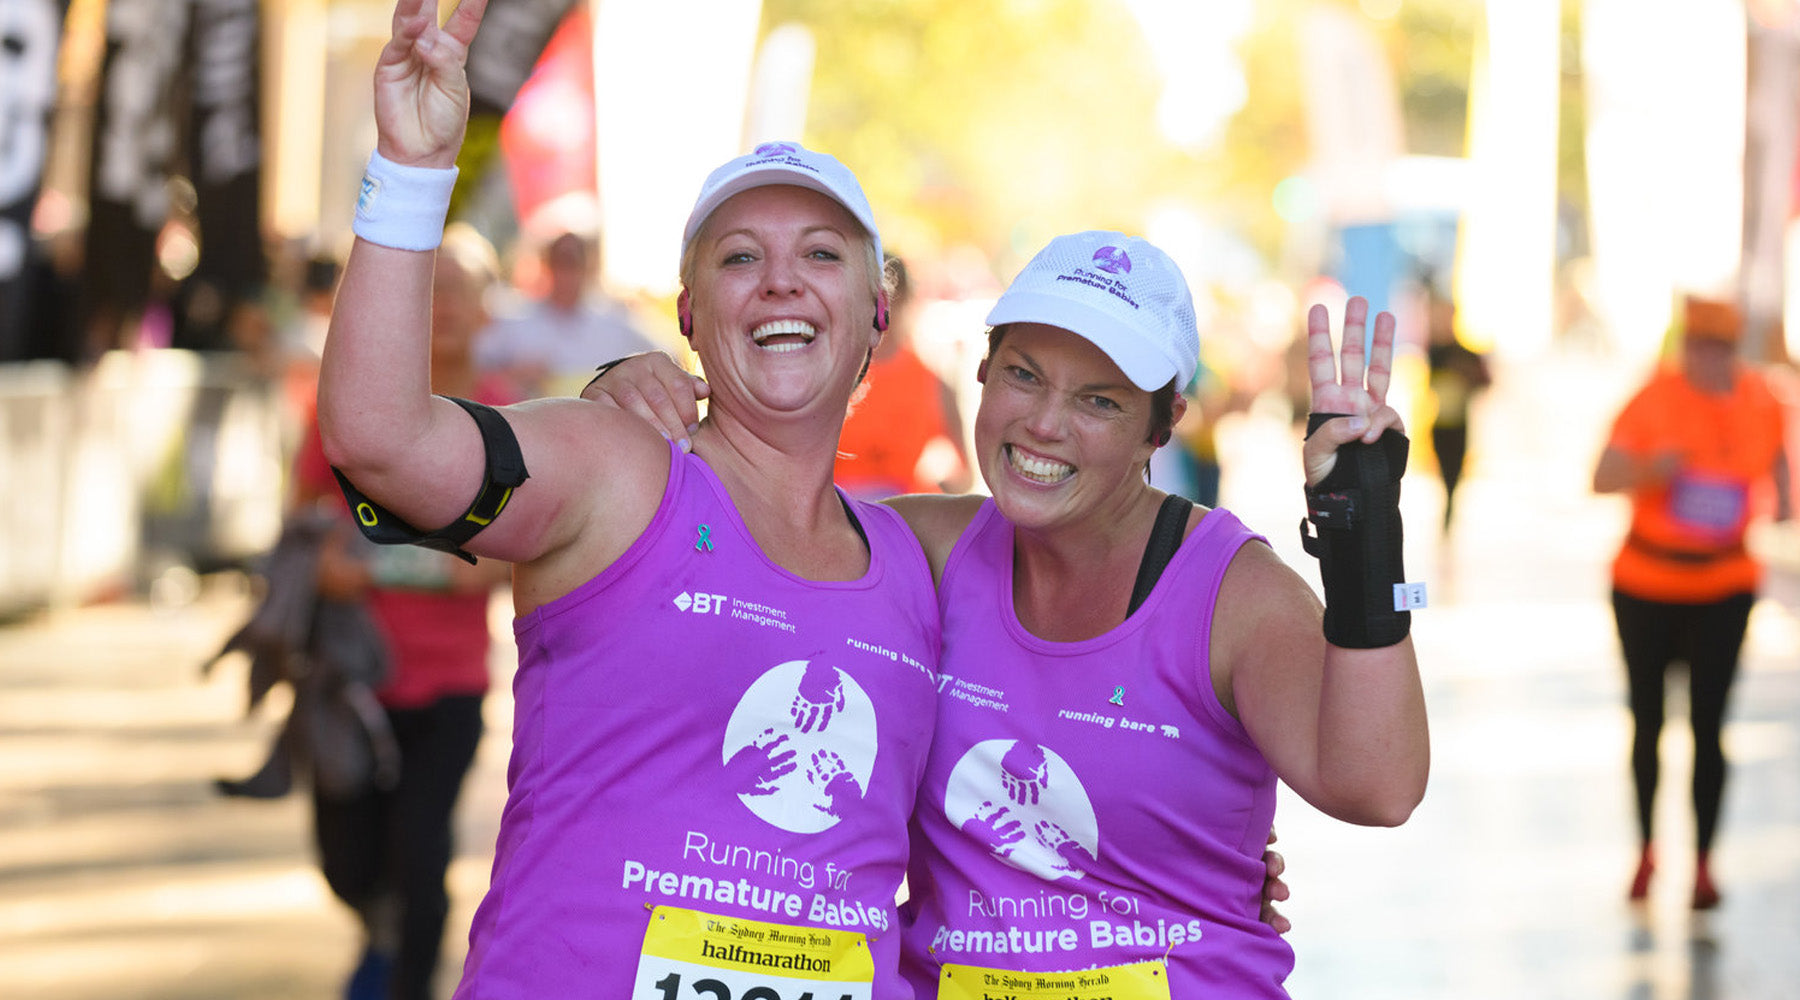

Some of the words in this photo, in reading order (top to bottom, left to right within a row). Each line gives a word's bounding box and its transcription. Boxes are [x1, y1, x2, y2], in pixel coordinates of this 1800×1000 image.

[1056, 274, 1107, 291] Premature
[1108, 286, 1140, 310] Babies
[1073, 267, 1113, 286] Running
[1114, 280, 1128, 292] for
[692, 592, 728, 616] BT
[732, 597, 787, 620] Investment
[731, 608, 796, 634] Management
[846, 637, 898, 662] running
[949, 687, 1009, 713] Management
[955, 678, 1004, 700] Investment
[1058, 709, 1115, 729] running
[1119, 716, 1156, 733] bare
[683, 831, 815, 889] Running
[622, 860, 802, 917] Premature
[808, 894, 889, 932] Babies
[968, 889, 1088, 920] Running
[706, 919, 726, 934] The
[729, 923, 765, 943] Sydney
[768, 929, 807, 947] Morning
[808, 933, 832, 948] Herald
[931, 924, 1078, 953] Premature
[1089, 919, 1203, 949] Babies
[701, 939, 832, 973] halfmarathon
[984, 974, 1000, 986] The
[1002, 975, 1032, 990] Sydney
[1035, 978, 1075, 990] Morning
[1078, 974, 1110, 989] Herald
